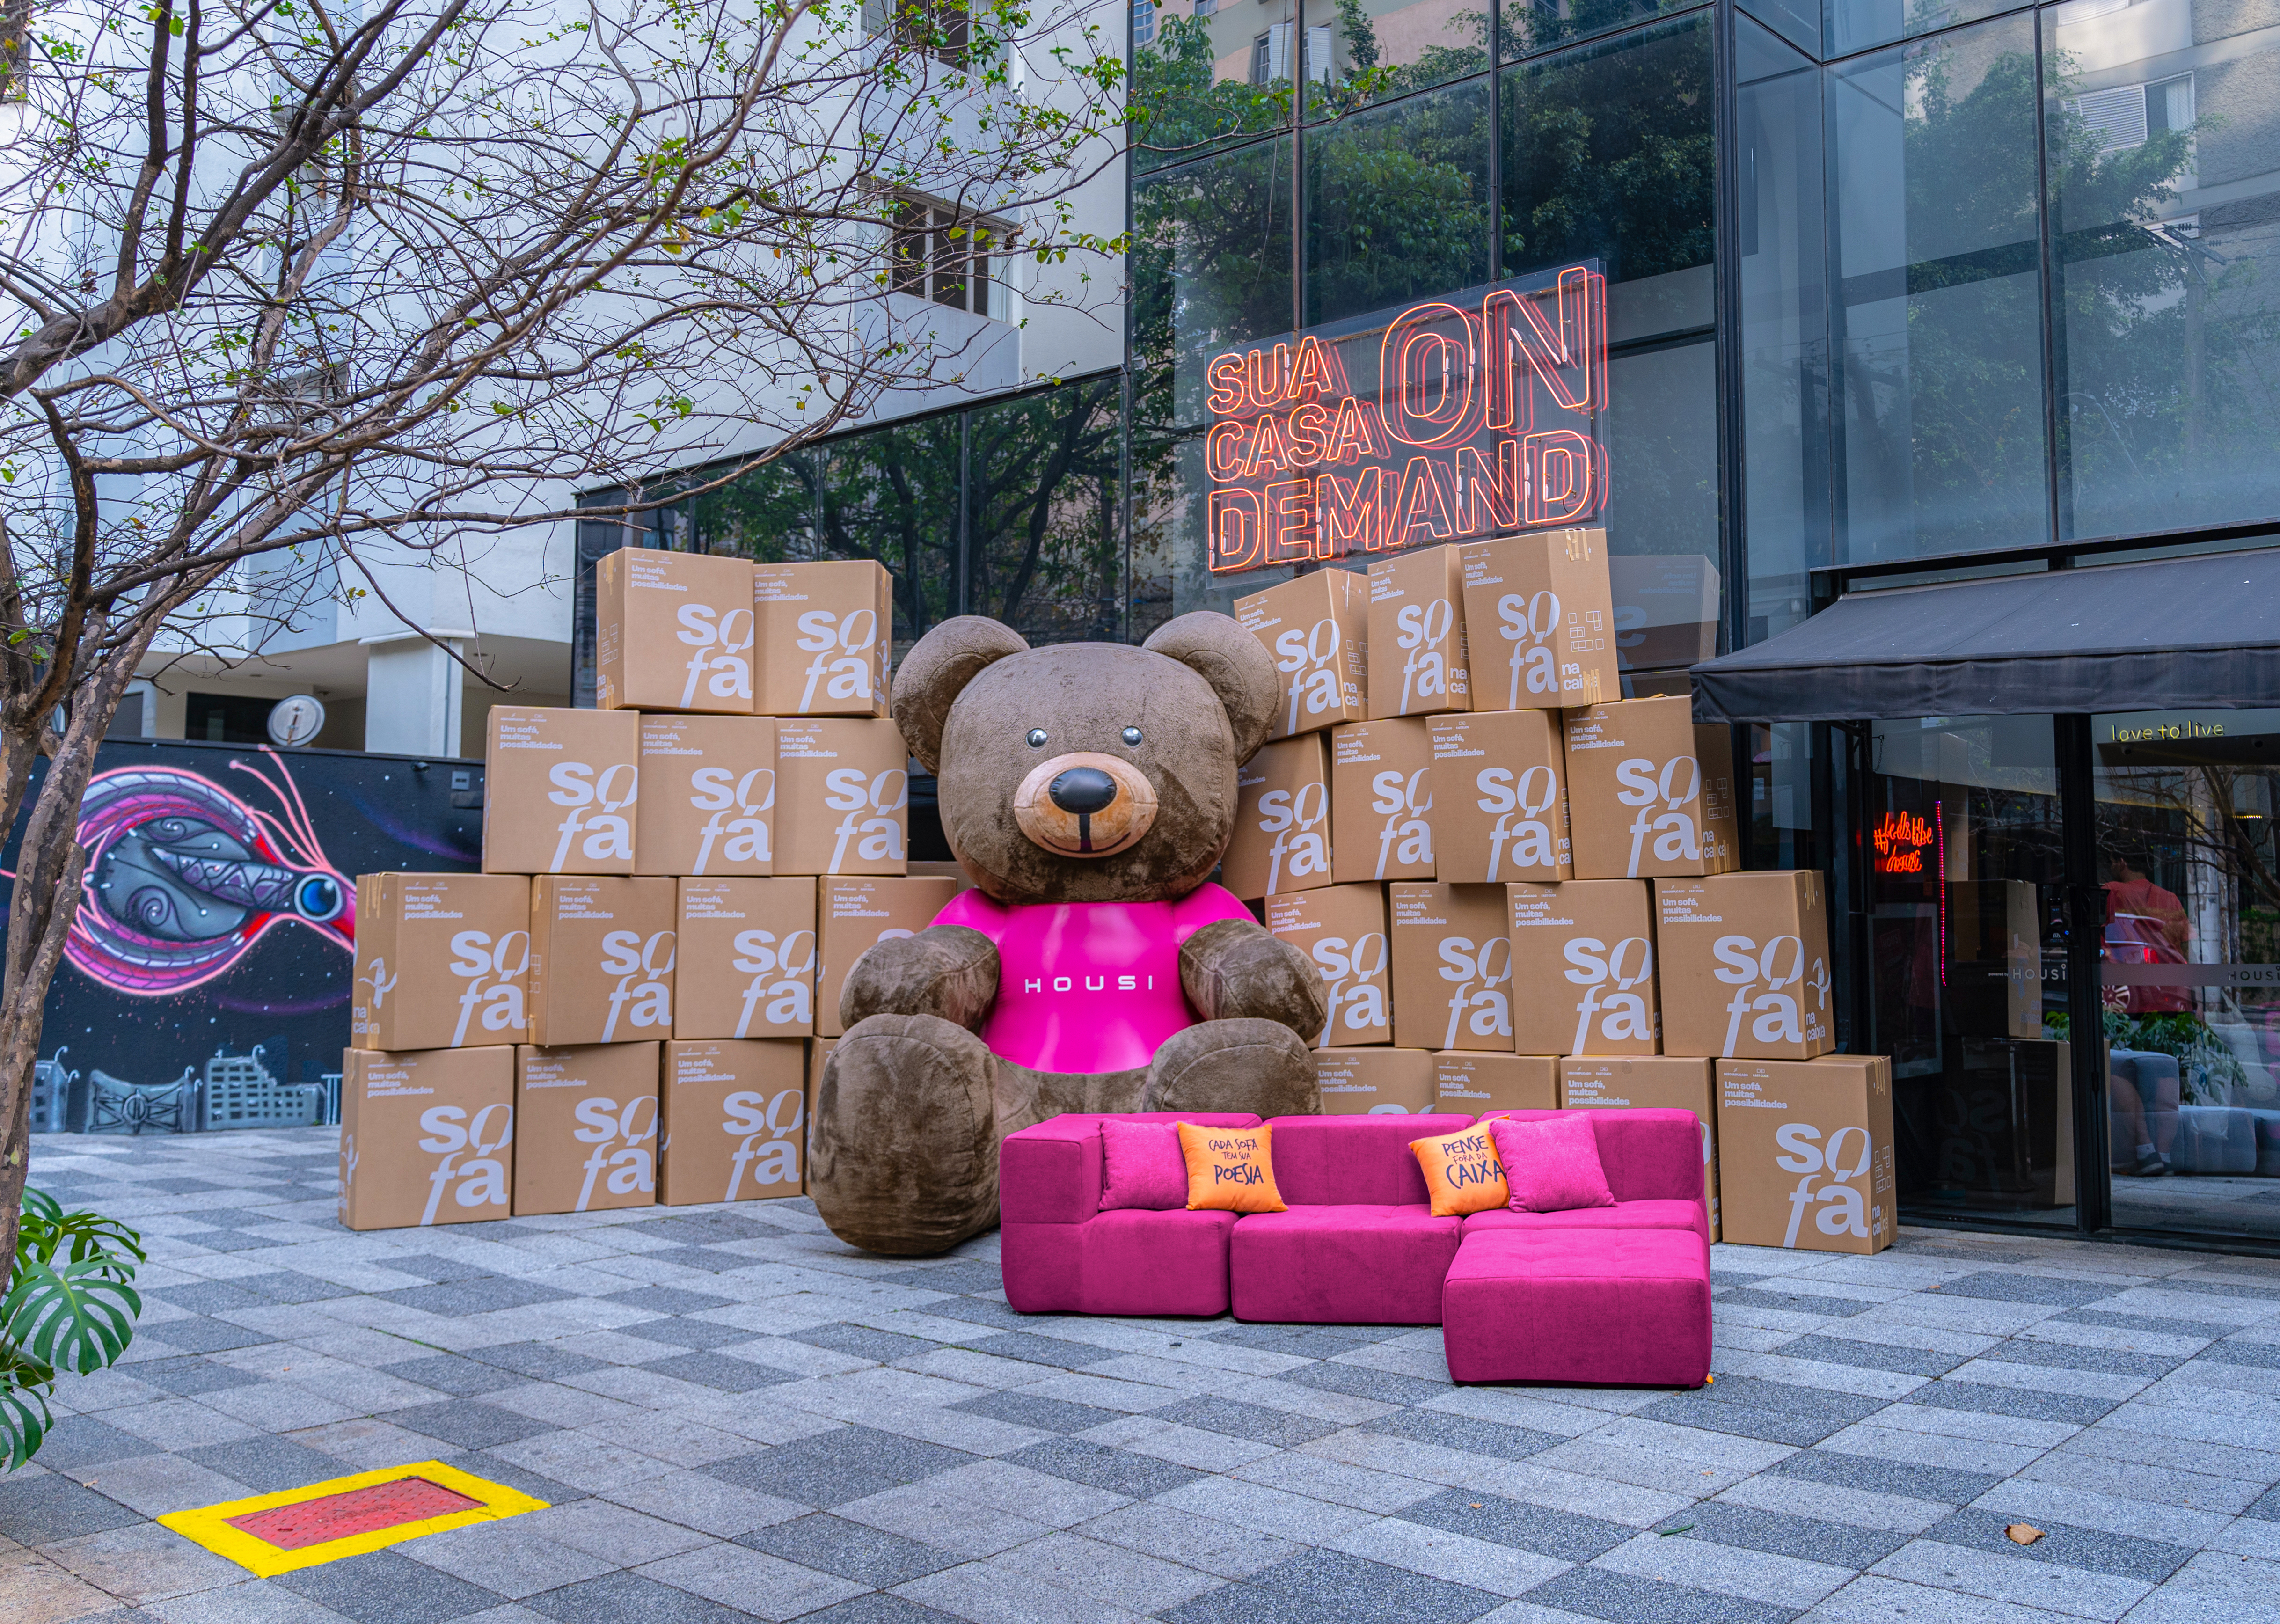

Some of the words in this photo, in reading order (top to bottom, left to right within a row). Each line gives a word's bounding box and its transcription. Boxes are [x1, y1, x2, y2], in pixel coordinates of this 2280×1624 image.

[1381, 266, 1589, 444] ON
[1207, 336, 1332, 413] SUA
[1206, 397, 1372, 482] CASA
[1209, 430, 1589, 571] DEMAND
[647, 567, 666, 576] sofá,
[1475, 562, 1487, 571] sofá,
[632, 581, 687, 591] possibilidades
[1380, 577, 1391, 587] sofá,
[1466, 576, 1503, 588] possibilidades
[1371, 587, 1388, 595] muitas
[1371, 589, 1404, 603] possibilidades
[754, 593, 808, 603] possibilidades
[1498, 591, 1560, 640] so
[676, 604, 754, 651] so
[797, 609, 877, 651] so
[1397, 599, 1453, 649] so
[1275, 619, 1340, 672] so
[1450, 668, 1467, 680] na
[1562, 663, 1579, 675] na
[1343, 682, 1357, 693] na
[1564, 674, 1597, 690] cai
[517, 726, 539, 735] sofá,
[1584, 725, 1603, 733] sofá,
[2112, 724, 2153, 741] love
[2157, 724, 2180, 739] to
[2188, 720, 2225, 736] live
[796, 736, 815, 744] sofá,
[1571, 733, 1597, 741] muitas
[1349, 740, 1363, 749] sofá,
[1571, 740, 1625, 751] possibilidades
[1337, 754, 1380, 765] possibilidades
[1434, 749, 1484, 760] possibilidades
[548, 762, 638, 807] so
[1616, 756, 1701, 806] so
[690, 767, 775, 811] so
[825, 768, 908, 810] so
[1372, 768, 1432, 814] so
[1476, 766, 1557, 813] so
[1258, 783, 1329, 832] so
[1703, 830, 1714, 842] na
[1558, 837, 1570, 849] na
[1410, 902, 1427, 911] sofá,
[1530, 902, 1550, 911] sofá,
[1678, 898, 1698, 907] sofá,
[1272, 916, 1295, 925] muitas
[1284, 909, 1301, 919] sofá,
[1664, 914, 1722, 924] possibilidades
[1272, 921, 1321, 935] possibilidades
[1516, 918, 1573, 927] possibilidades
[450, 930, 530, 977] so
[600, 930, 675, 975] so
[732, 929, 815, 973] so
[1312, 933, 1388, 980] so
[1438, 937, 1511, 981] so
[1564, 937, 1653, 984] so
[1713, 935, 1805, 984] so
[1024, 975, 1152, 993] HOUSI
[353, 1007, 366, 1018] na
[1806, 1012, 1815, 1025] na
[1584, 1080, 1605, 1090] sofá,
[1740, 1082, 1762, 1091] sofá,
[1725, 1090, 1754, 1098] muitas
[1569, 1097, 1630, 1105] possibilidades
[1725, 1099, 1787, 1109] possibilidades
[723, 1089, 804, 1135] so
[574, 1096, 658, 1143] so
[418, 1104, 513, 1154] so
[1209, 1140, 1233, 1151] CADA
[1442, 1135, 1488, 1156] PENSE
[1776, 1123, 1871, 1177] so
[1239, 1151, 1251, 1160] SUA
[1453, 1154, 1475, 1164] FORA
[1214, 1163, 1264, 1185] POESIA
[1446, 1160, 1507, 1189] CAIXA
[1872, 1205, 1880, 1220] na
